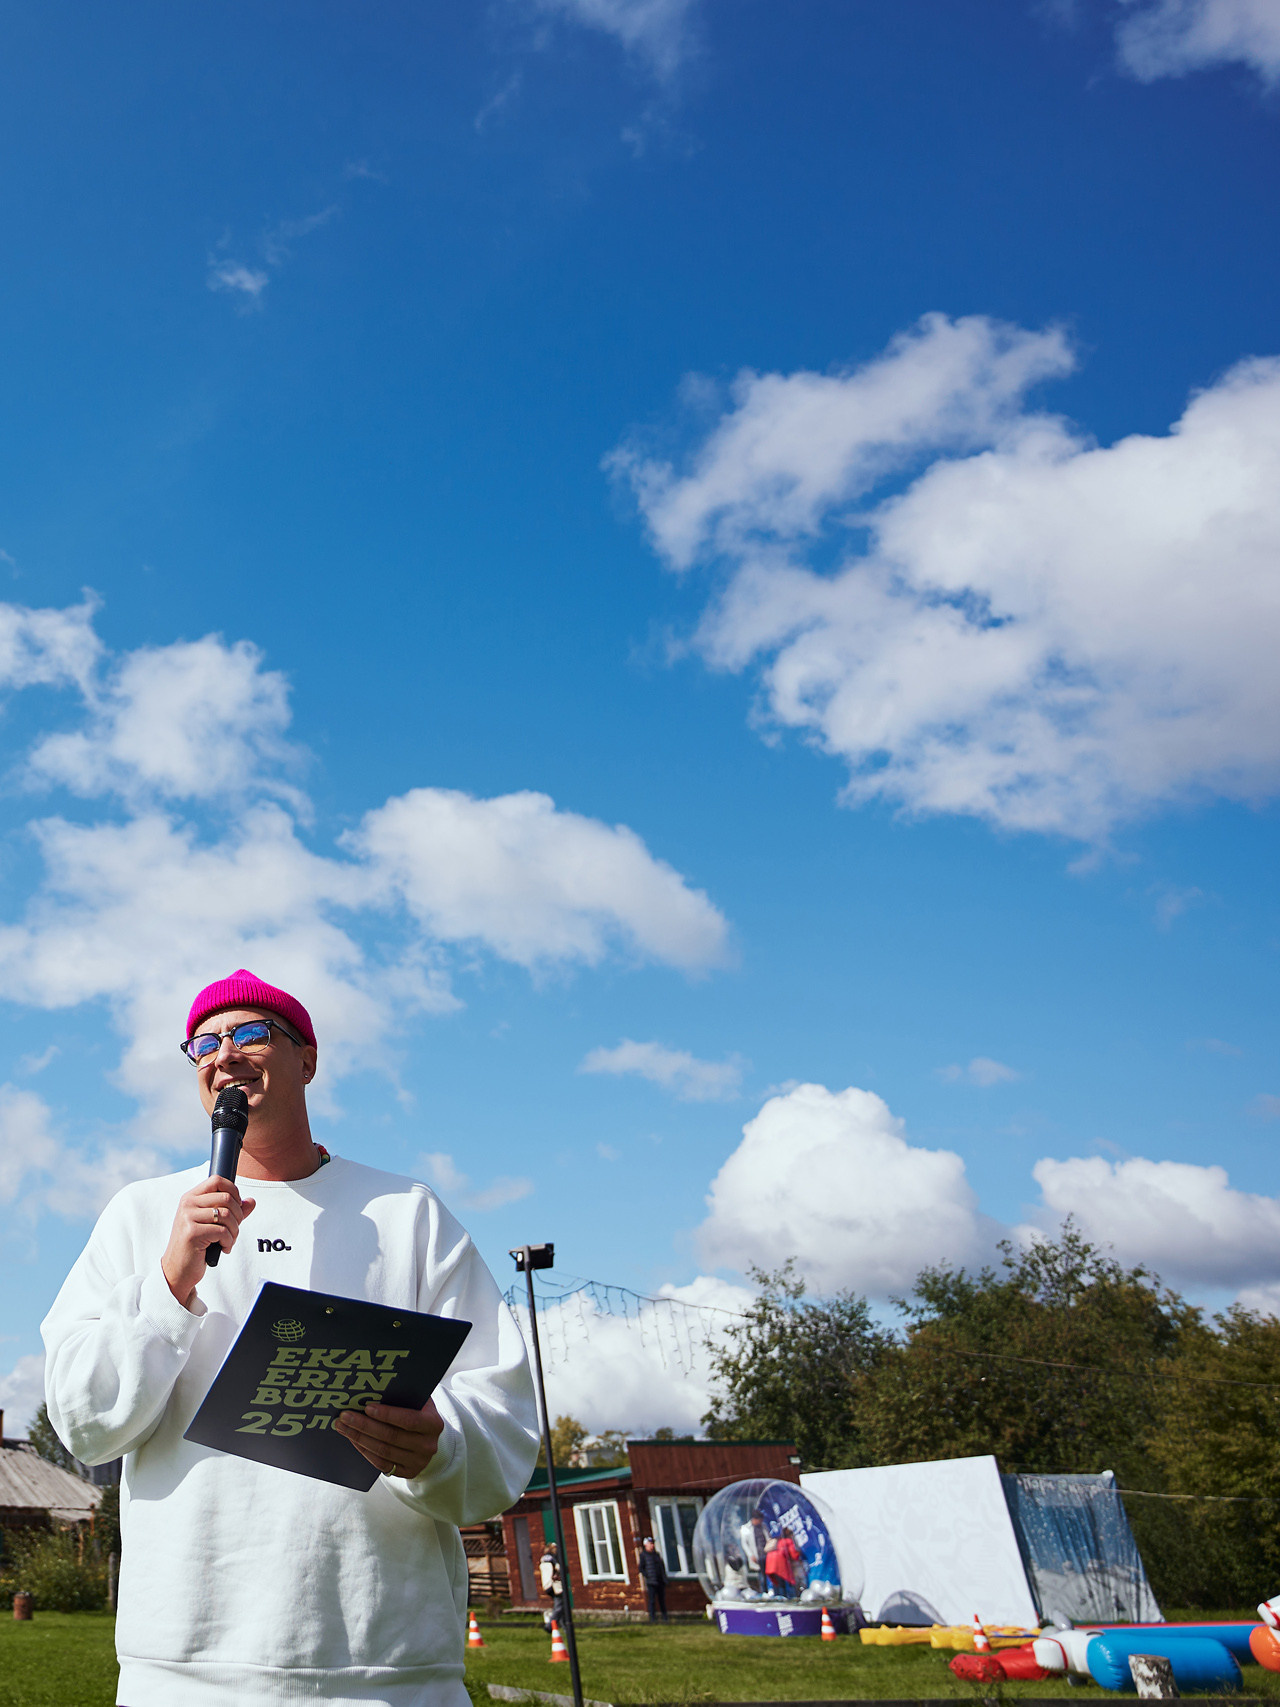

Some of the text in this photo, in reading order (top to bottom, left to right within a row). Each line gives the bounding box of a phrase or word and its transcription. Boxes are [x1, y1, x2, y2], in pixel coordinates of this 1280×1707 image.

[257, 1238, 292, 1252] no.
[270, 1347, 410, 1370] EKAT
[259, 1367, 398, 1391] ERIN
[250, 1387, 383, 1410] BURG
